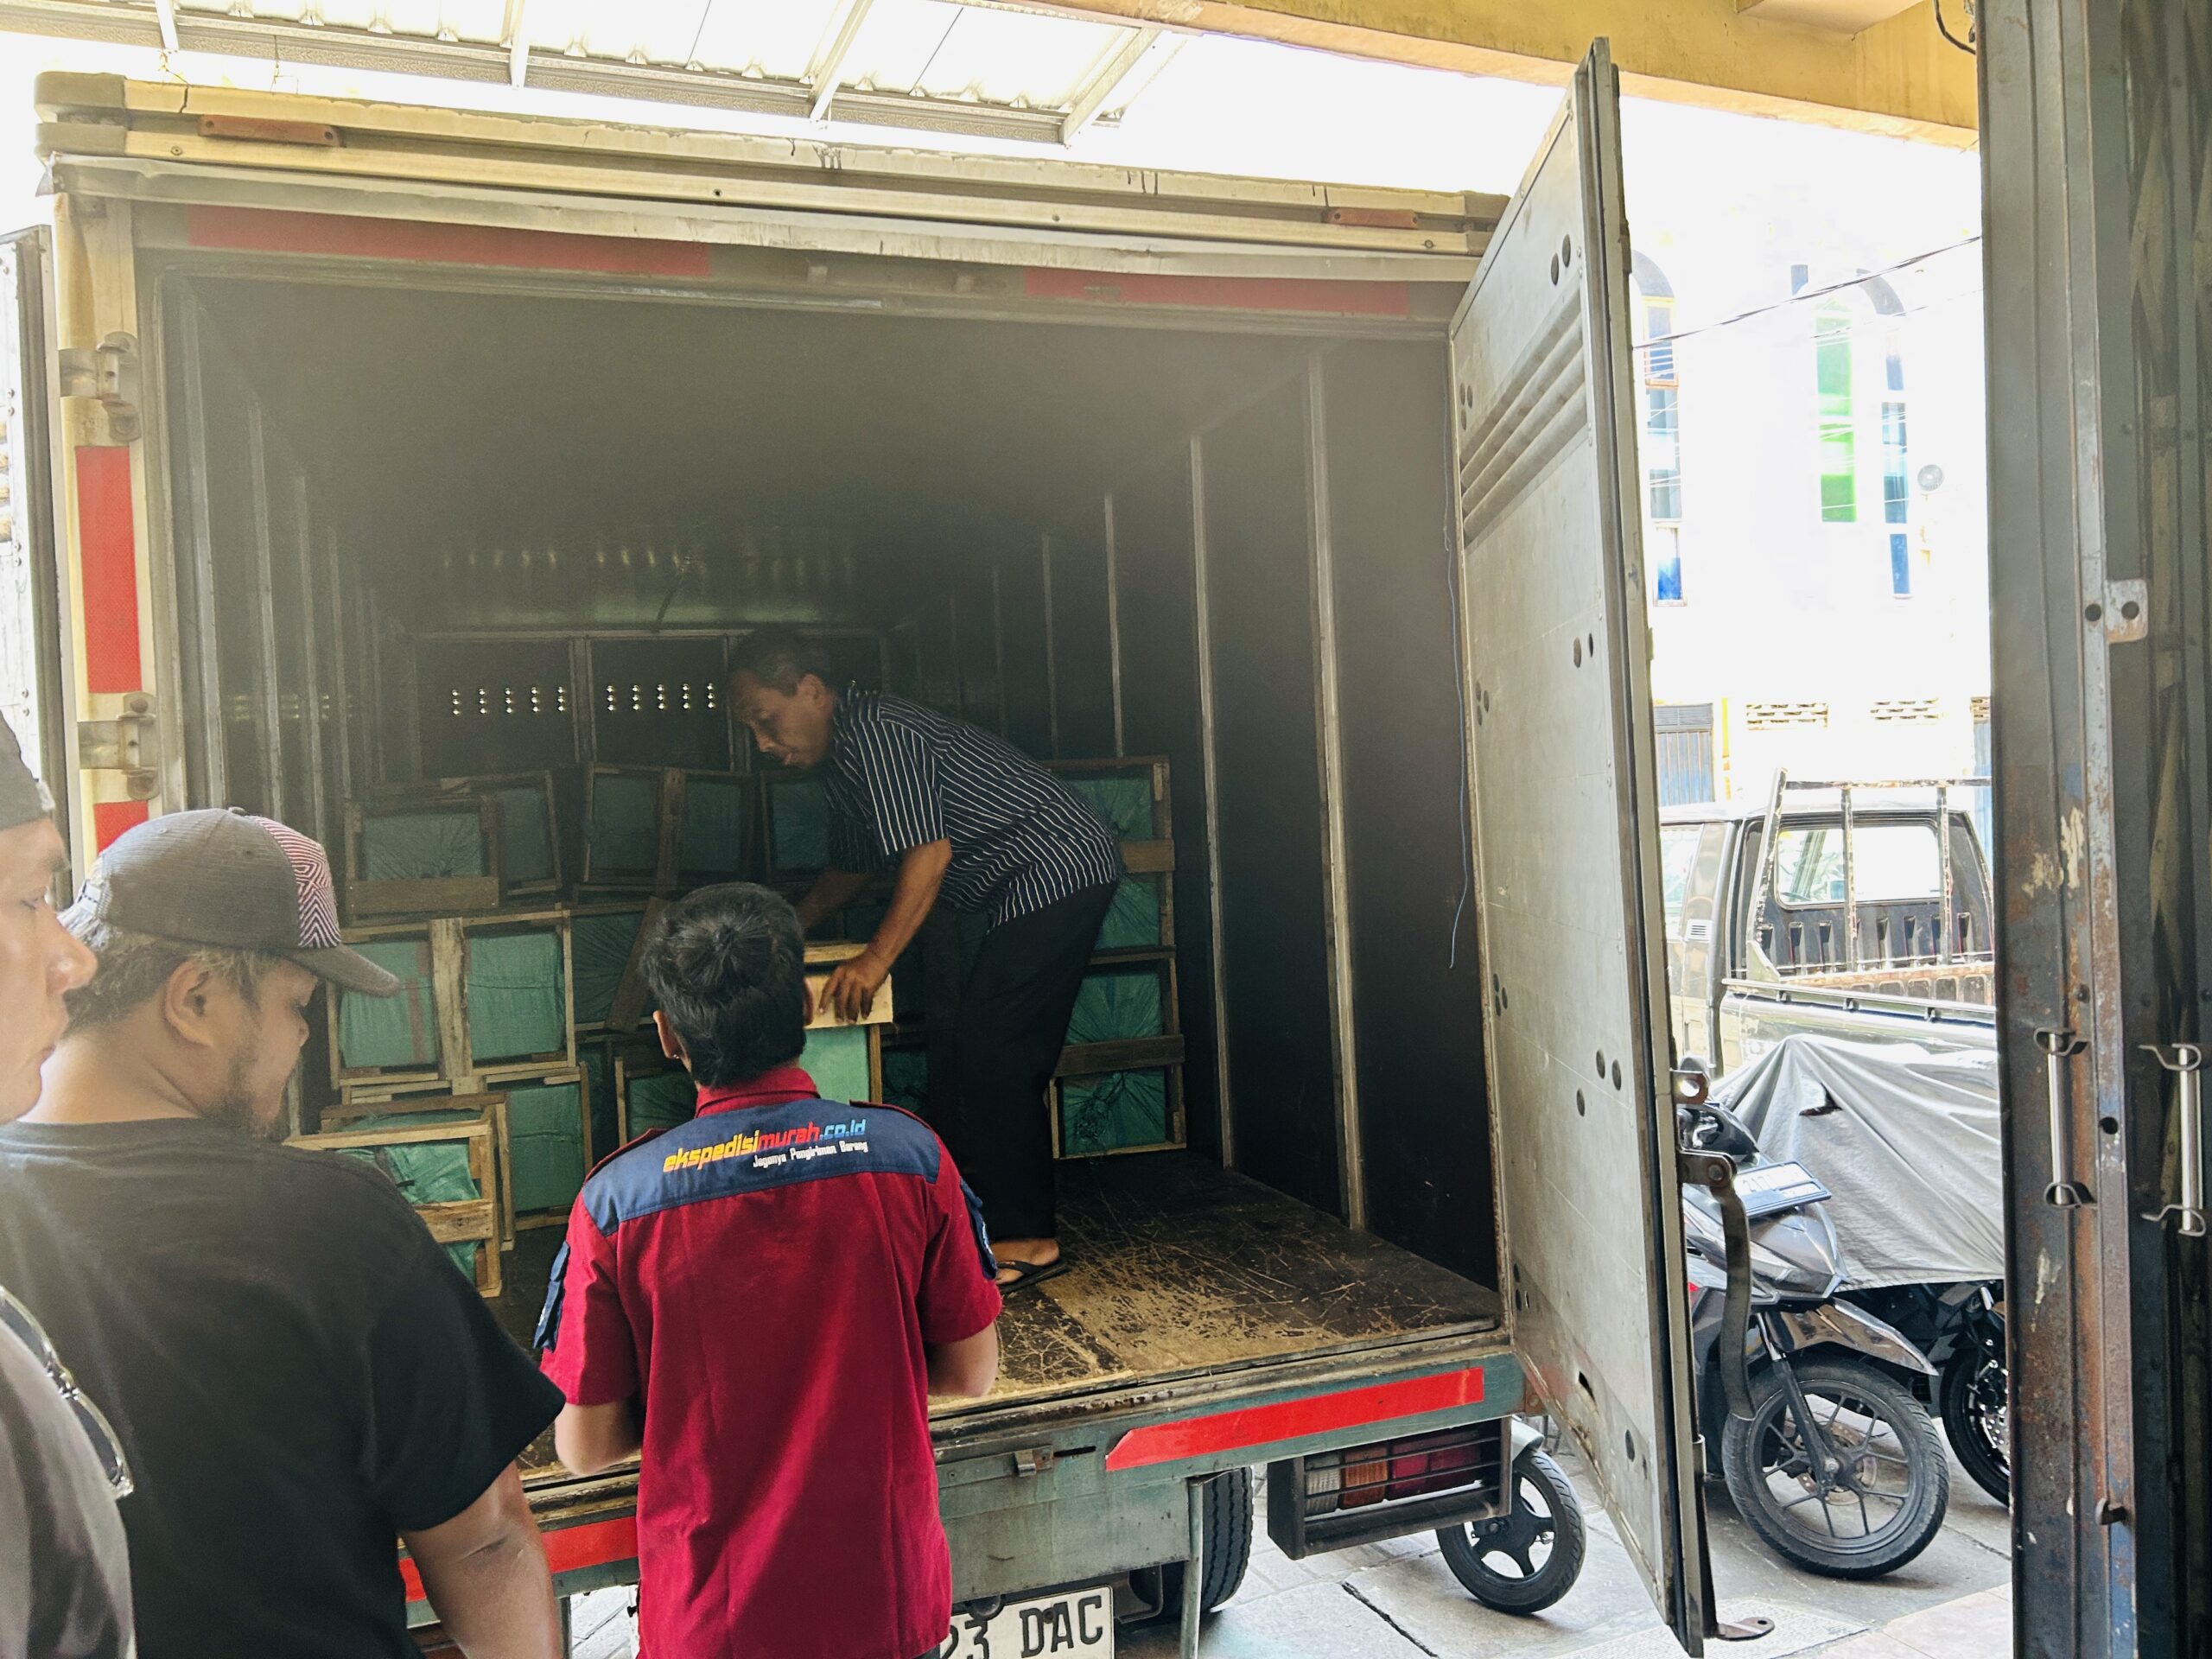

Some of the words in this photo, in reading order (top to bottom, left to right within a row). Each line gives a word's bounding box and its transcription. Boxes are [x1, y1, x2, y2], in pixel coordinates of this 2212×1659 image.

[663, 1119, 866, 1173] ekspedisimurah.co.id
[789, 1147, 837, 1160] Pengiriman
[838, 1140, 868, 1154] Barang
[1019, 1595, 1103, 1658] DAC
